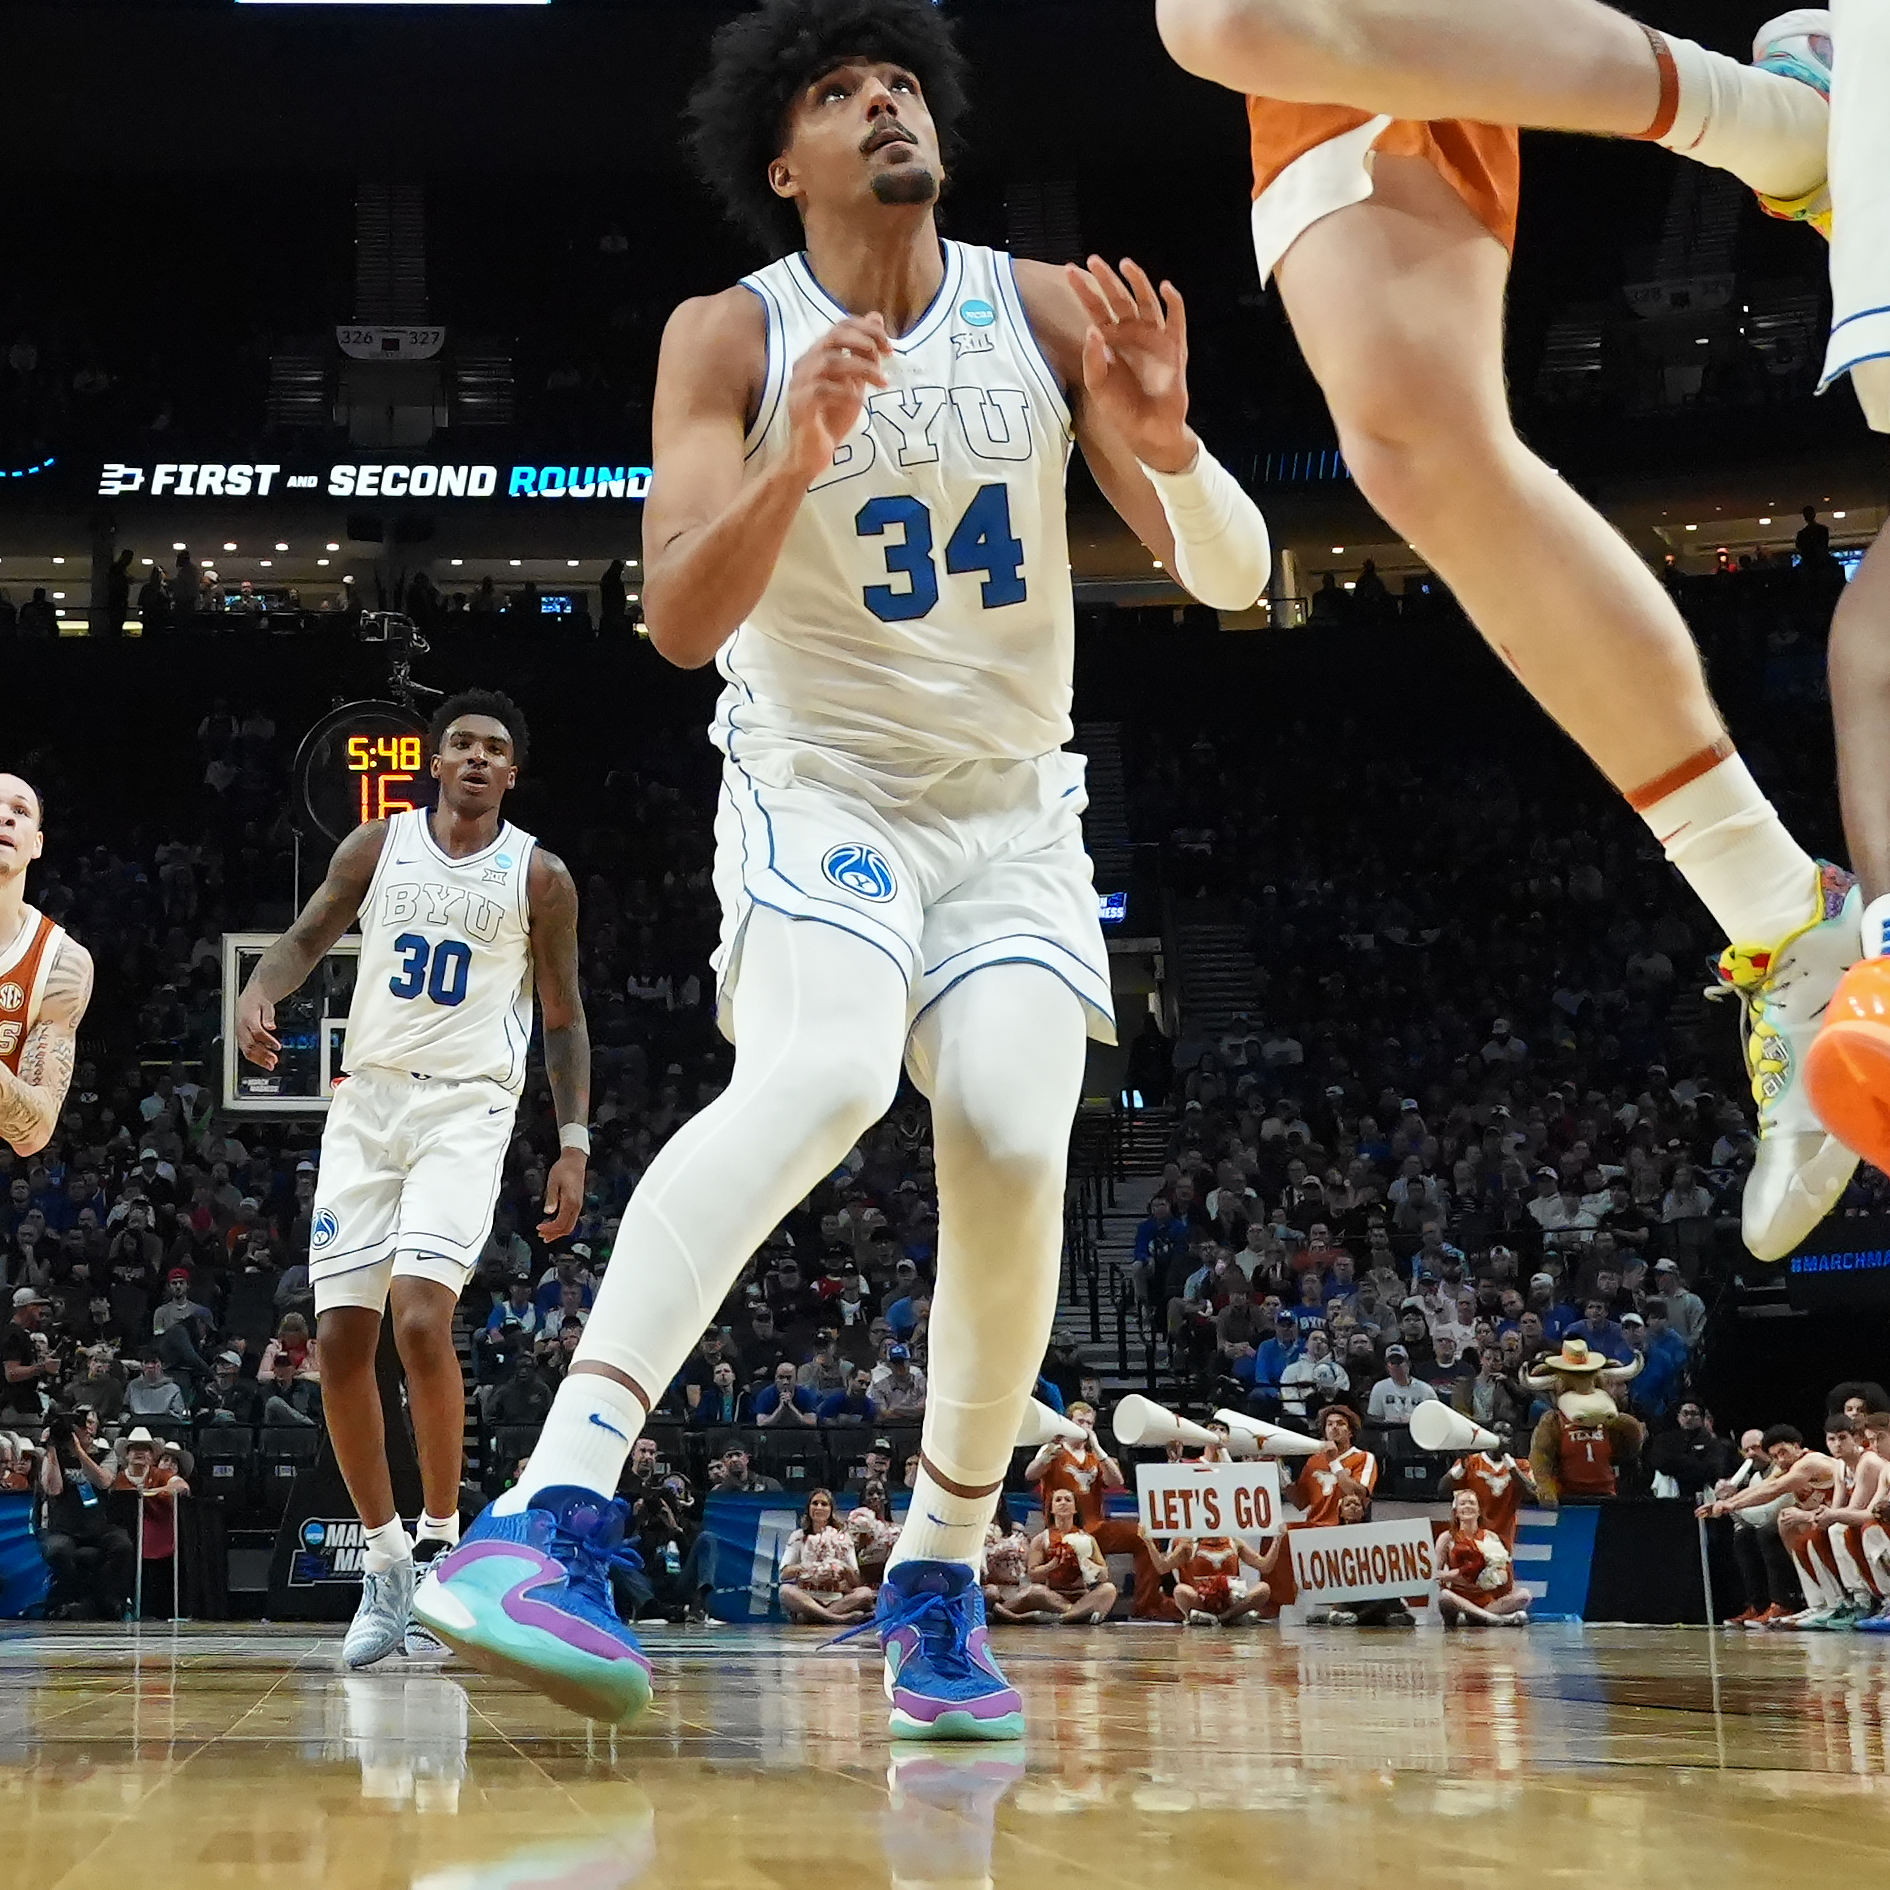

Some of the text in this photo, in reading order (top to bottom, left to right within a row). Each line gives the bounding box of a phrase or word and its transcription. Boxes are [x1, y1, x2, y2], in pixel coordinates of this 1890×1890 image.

[806, 386, 1032, 493] BYU
[151, 464, 497, 496] FIRST AND SECOND
[854, 483, 1027, 622] 34
[348, 737, 421, 771] 5:48
[382, 883, 505, 942] BYU
[389, 933, 472, 1006] 30
[1148, 1484, 1272, 1531] LET'S GO
[1298, 1540, 1432, 1590] LONGHORNS
